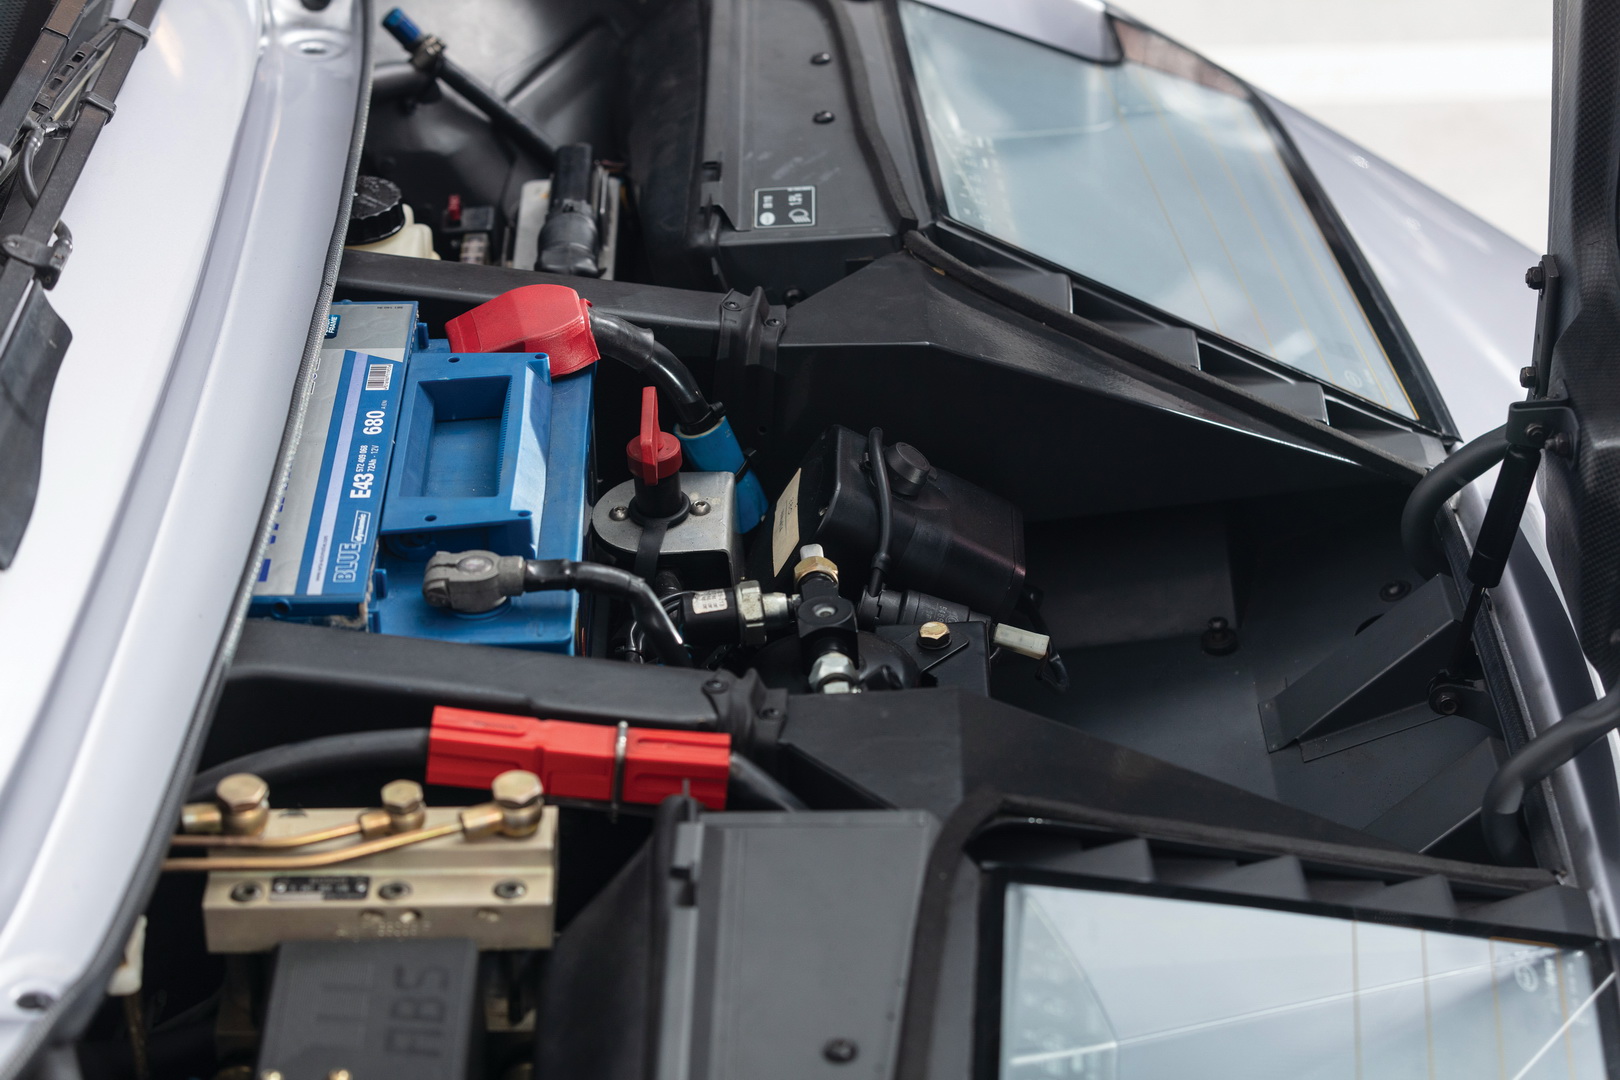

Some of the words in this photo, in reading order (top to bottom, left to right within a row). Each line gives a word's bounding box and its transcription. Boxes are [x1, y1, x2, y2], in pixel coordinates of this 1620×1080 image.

[328, 316, 338, 334] FRAME
[362, 410, 386, 435] 680
[359, 444, 369, 454] 068
[370, 444, 380, 454] 12V
[357, 454, 367, 463] 409
[367, 459, 377, 472] 72Ah
[355, 463, 365, 473] 572
[349, 473, 375, 499] E43
[333, 542, 362, 583] BLUE
[383, 963, 450, 1060] ABS
